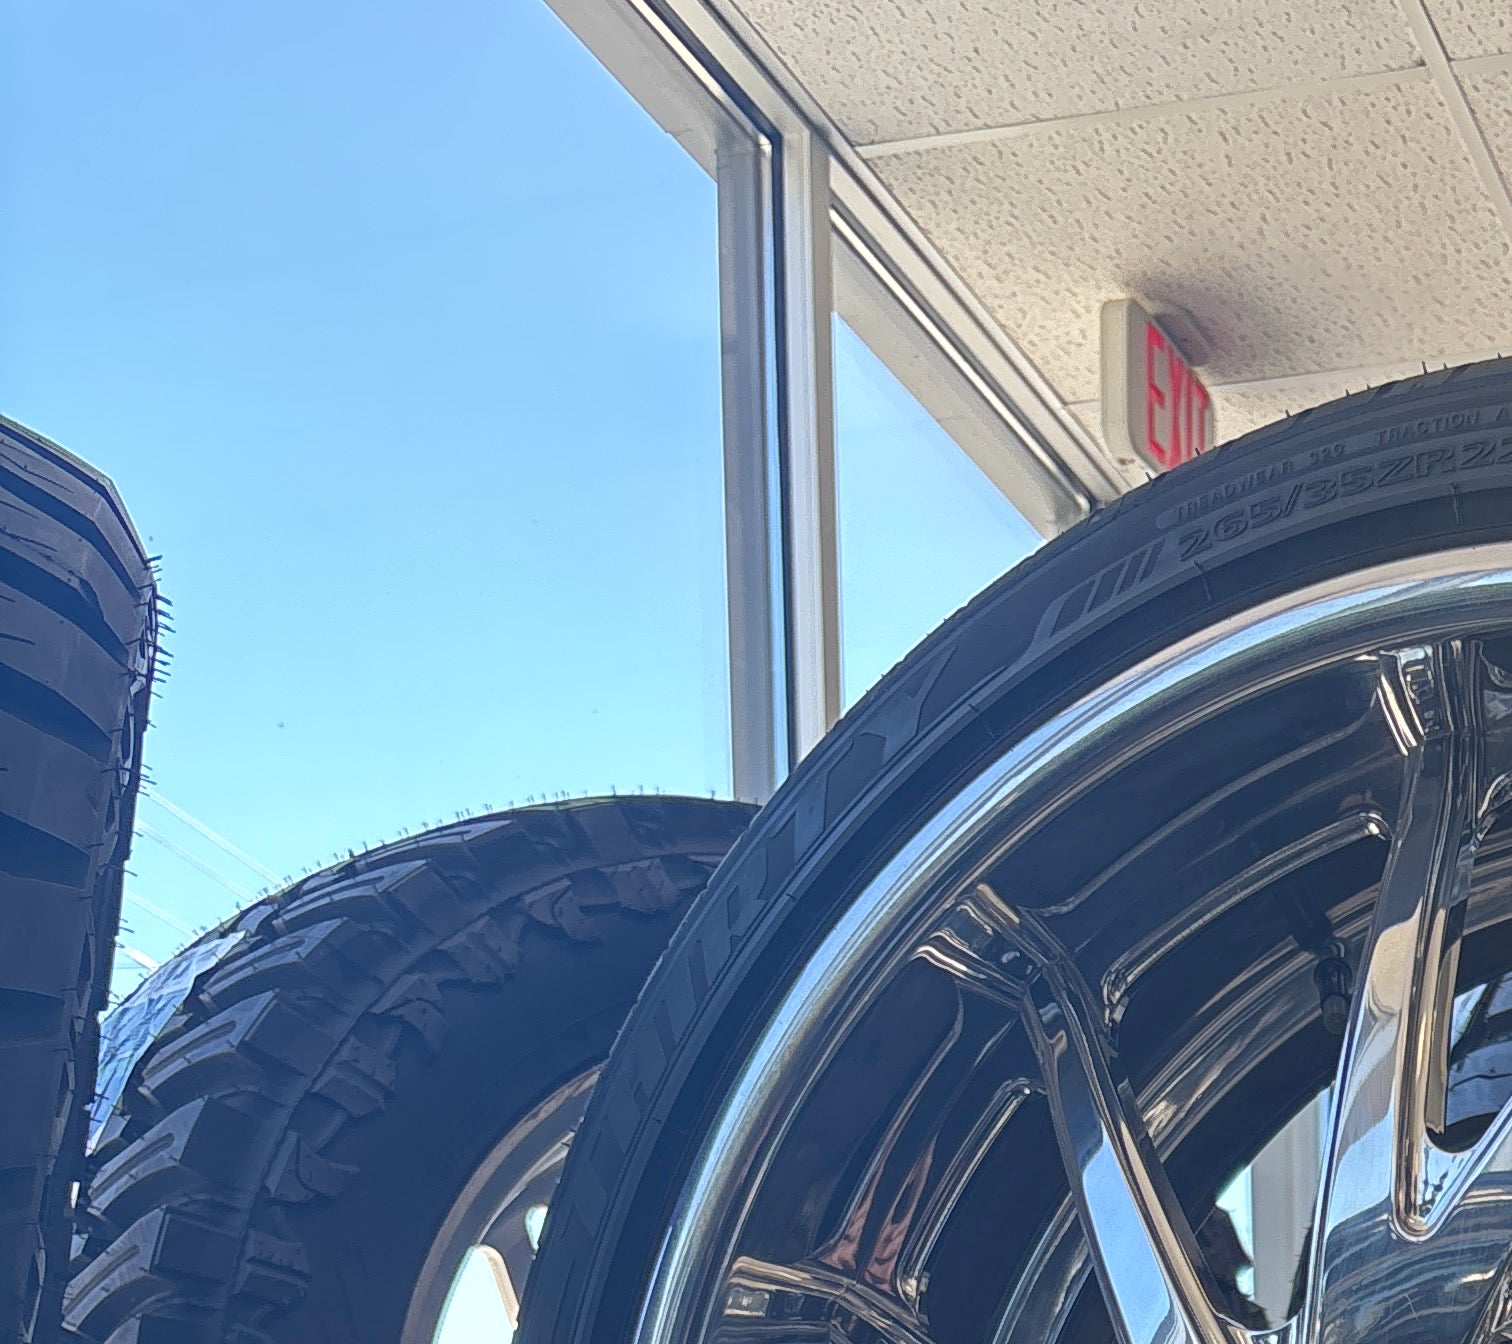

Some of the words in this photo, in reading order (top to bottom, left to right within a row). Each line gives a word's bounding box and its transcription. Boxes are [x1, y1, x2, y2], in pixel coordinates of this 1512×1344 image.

[1146, 321, 1209, 470] EXIT
[1176, 459, 1294, 520] TREADWEAR
[1376, 408, 1480, 444] TRACTION
